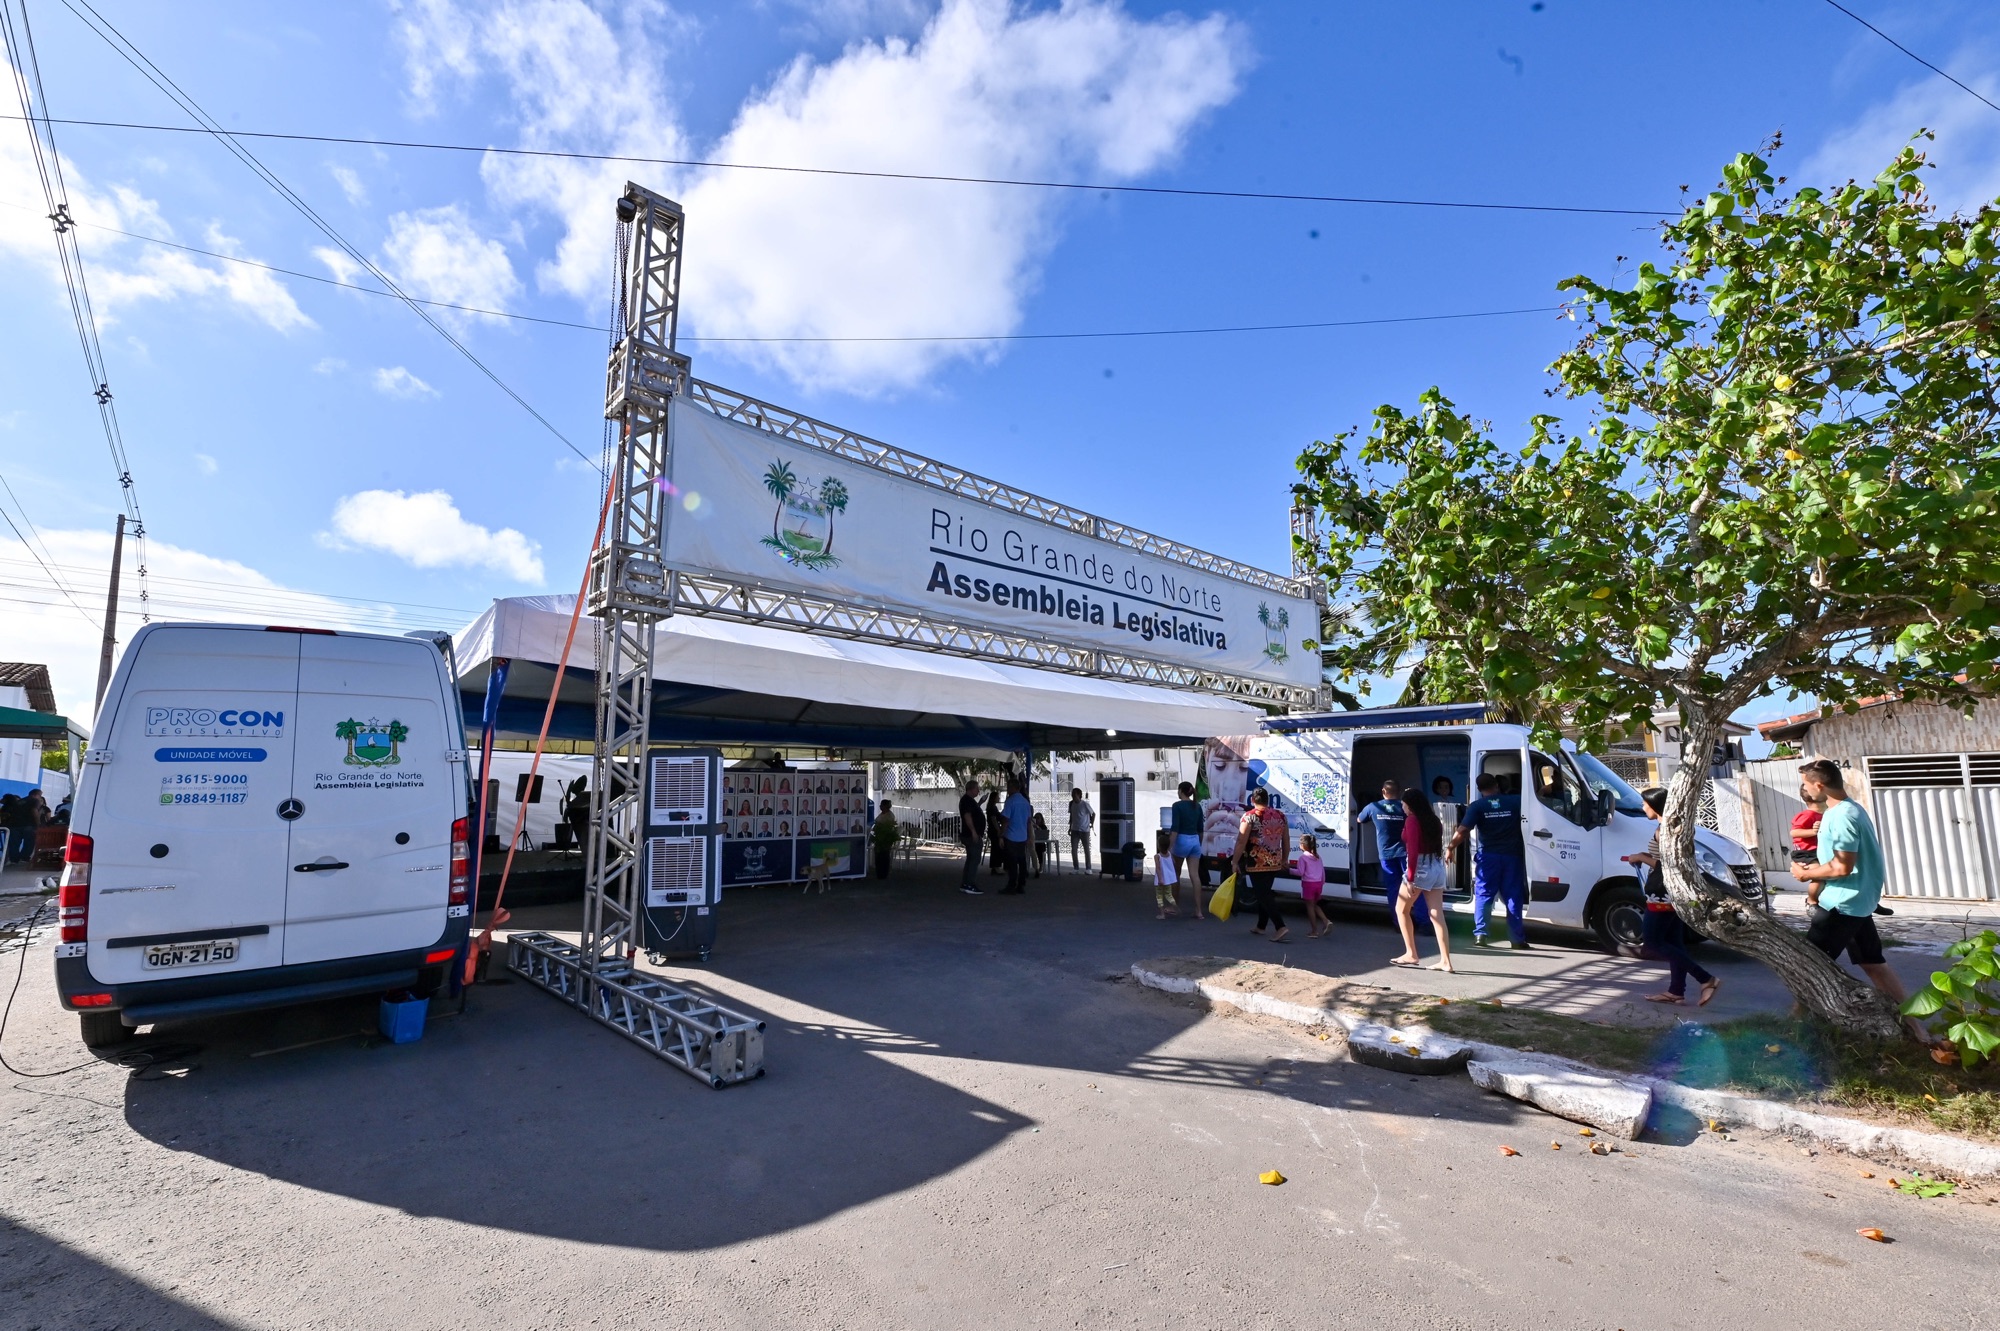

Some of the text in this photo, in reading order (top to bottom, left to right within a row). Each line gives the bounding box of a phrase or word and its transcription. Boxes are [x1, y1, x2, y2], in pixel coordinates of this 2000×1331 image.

[931, 508, 1221, 612] Rio Grande do Norte
[926, 561, 1227, 650] Assembleia Legislativa
[149, 708, 284, 727] PROCON
[149, 728, 281, 736] LEGISLATIVO
[170, 750, 253, 759] UNIDADE MÓVEL
[161, 774, 248, 785] 84 3615-9000
[315, 772, 422, 781] Rio Grande do Norte
[374, 780, 425, 789] Legislativa
[174, 793, 247, 804] 98849-1187
